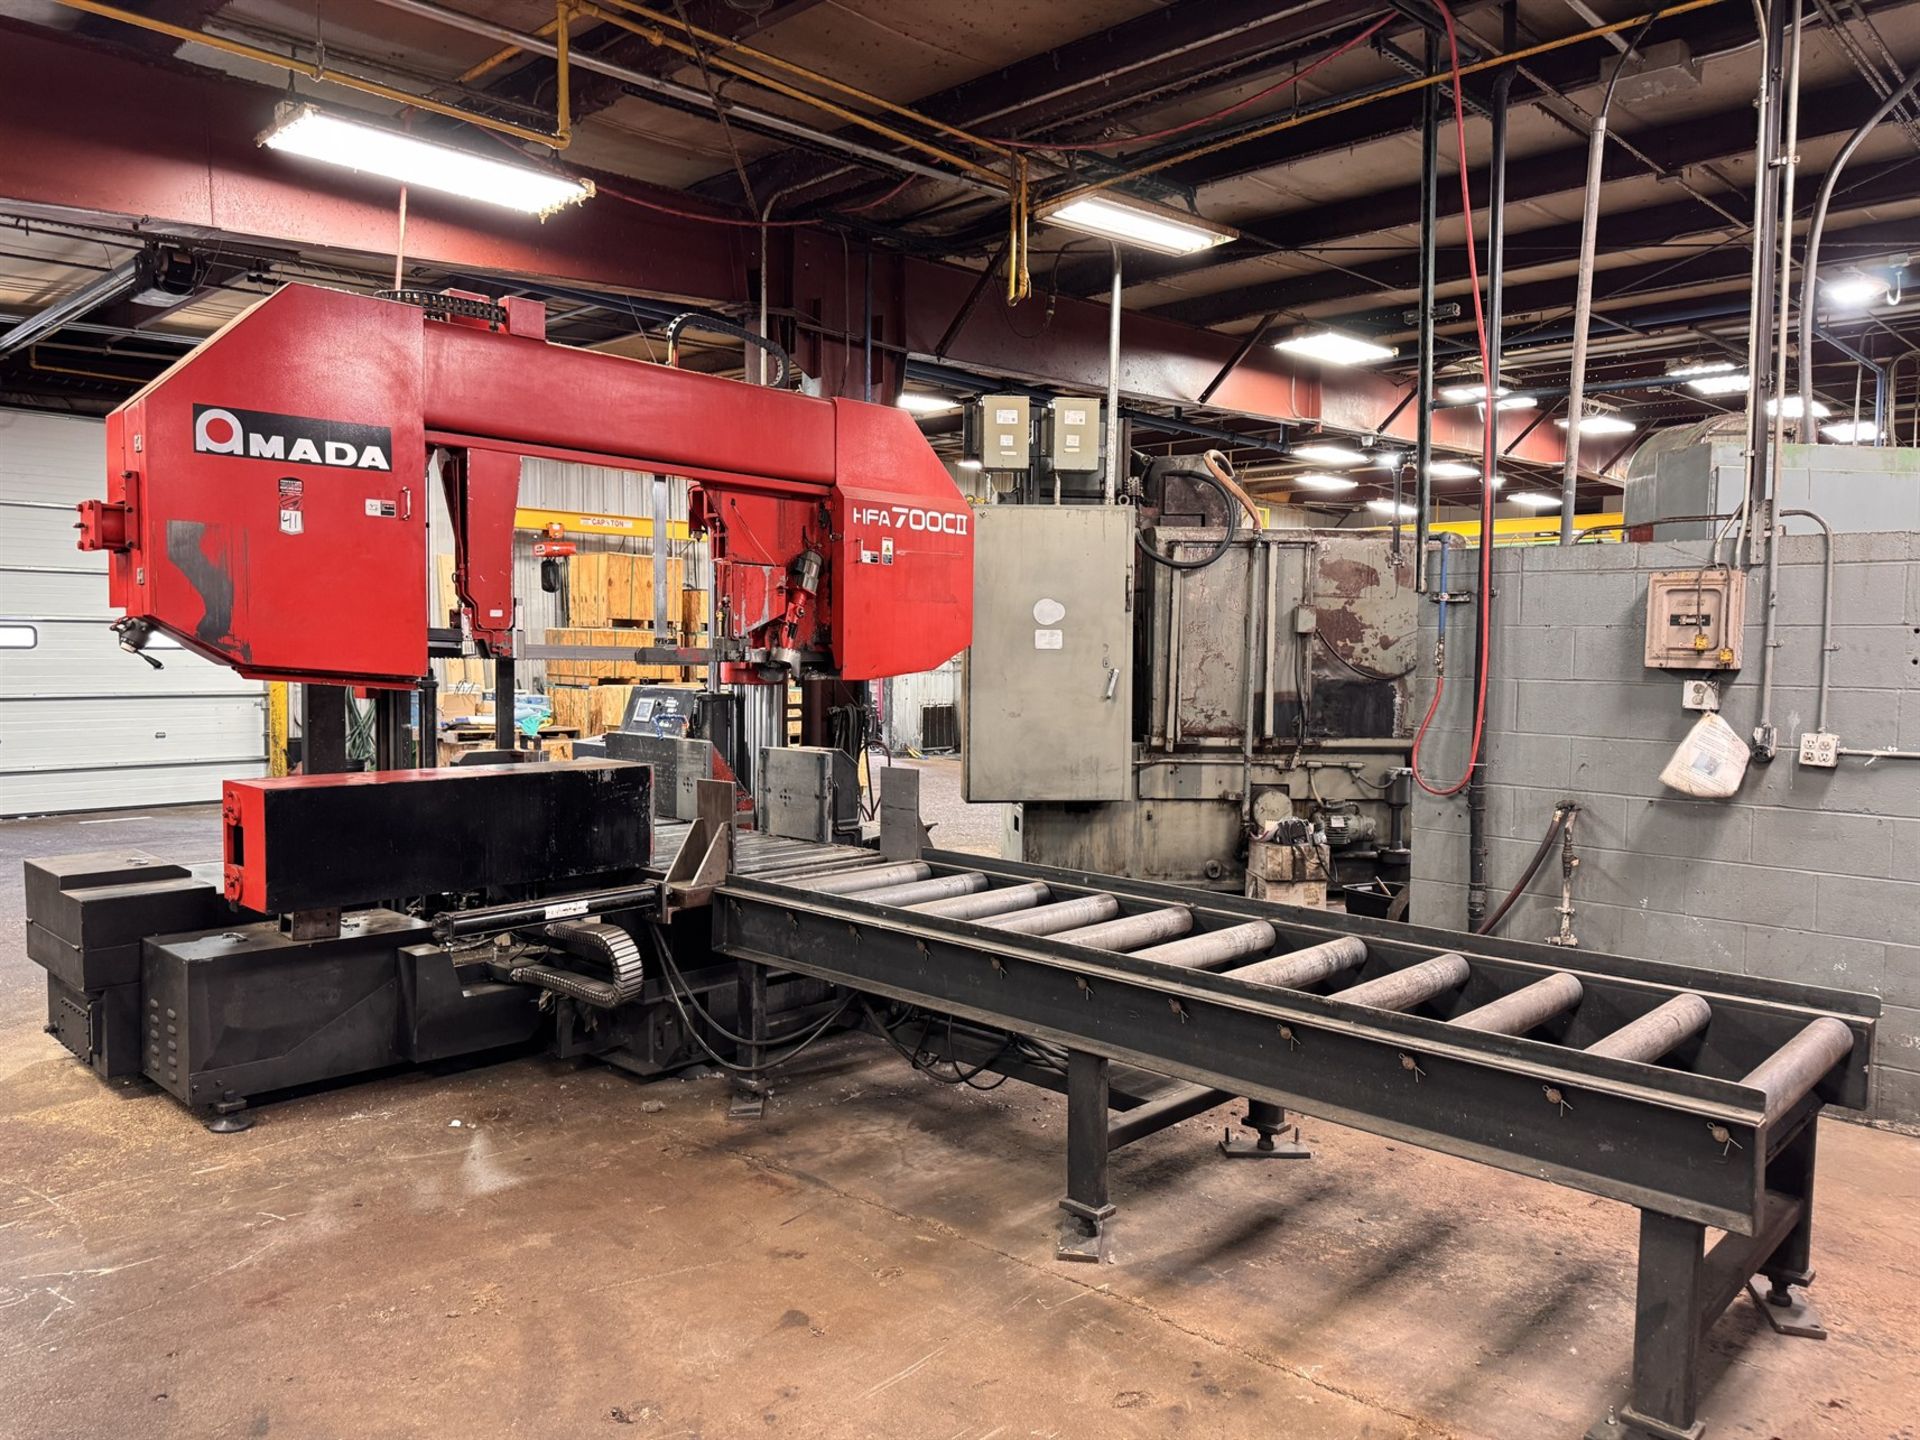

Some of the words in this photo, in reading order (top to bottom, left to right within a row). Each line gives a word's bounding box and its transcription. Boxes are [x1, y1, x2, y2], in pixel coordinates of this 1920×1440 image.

[195, 408, 390, 471] AMADA
[282, 512, 298, 529] 41
[853, 507, 891, 527] HFA
